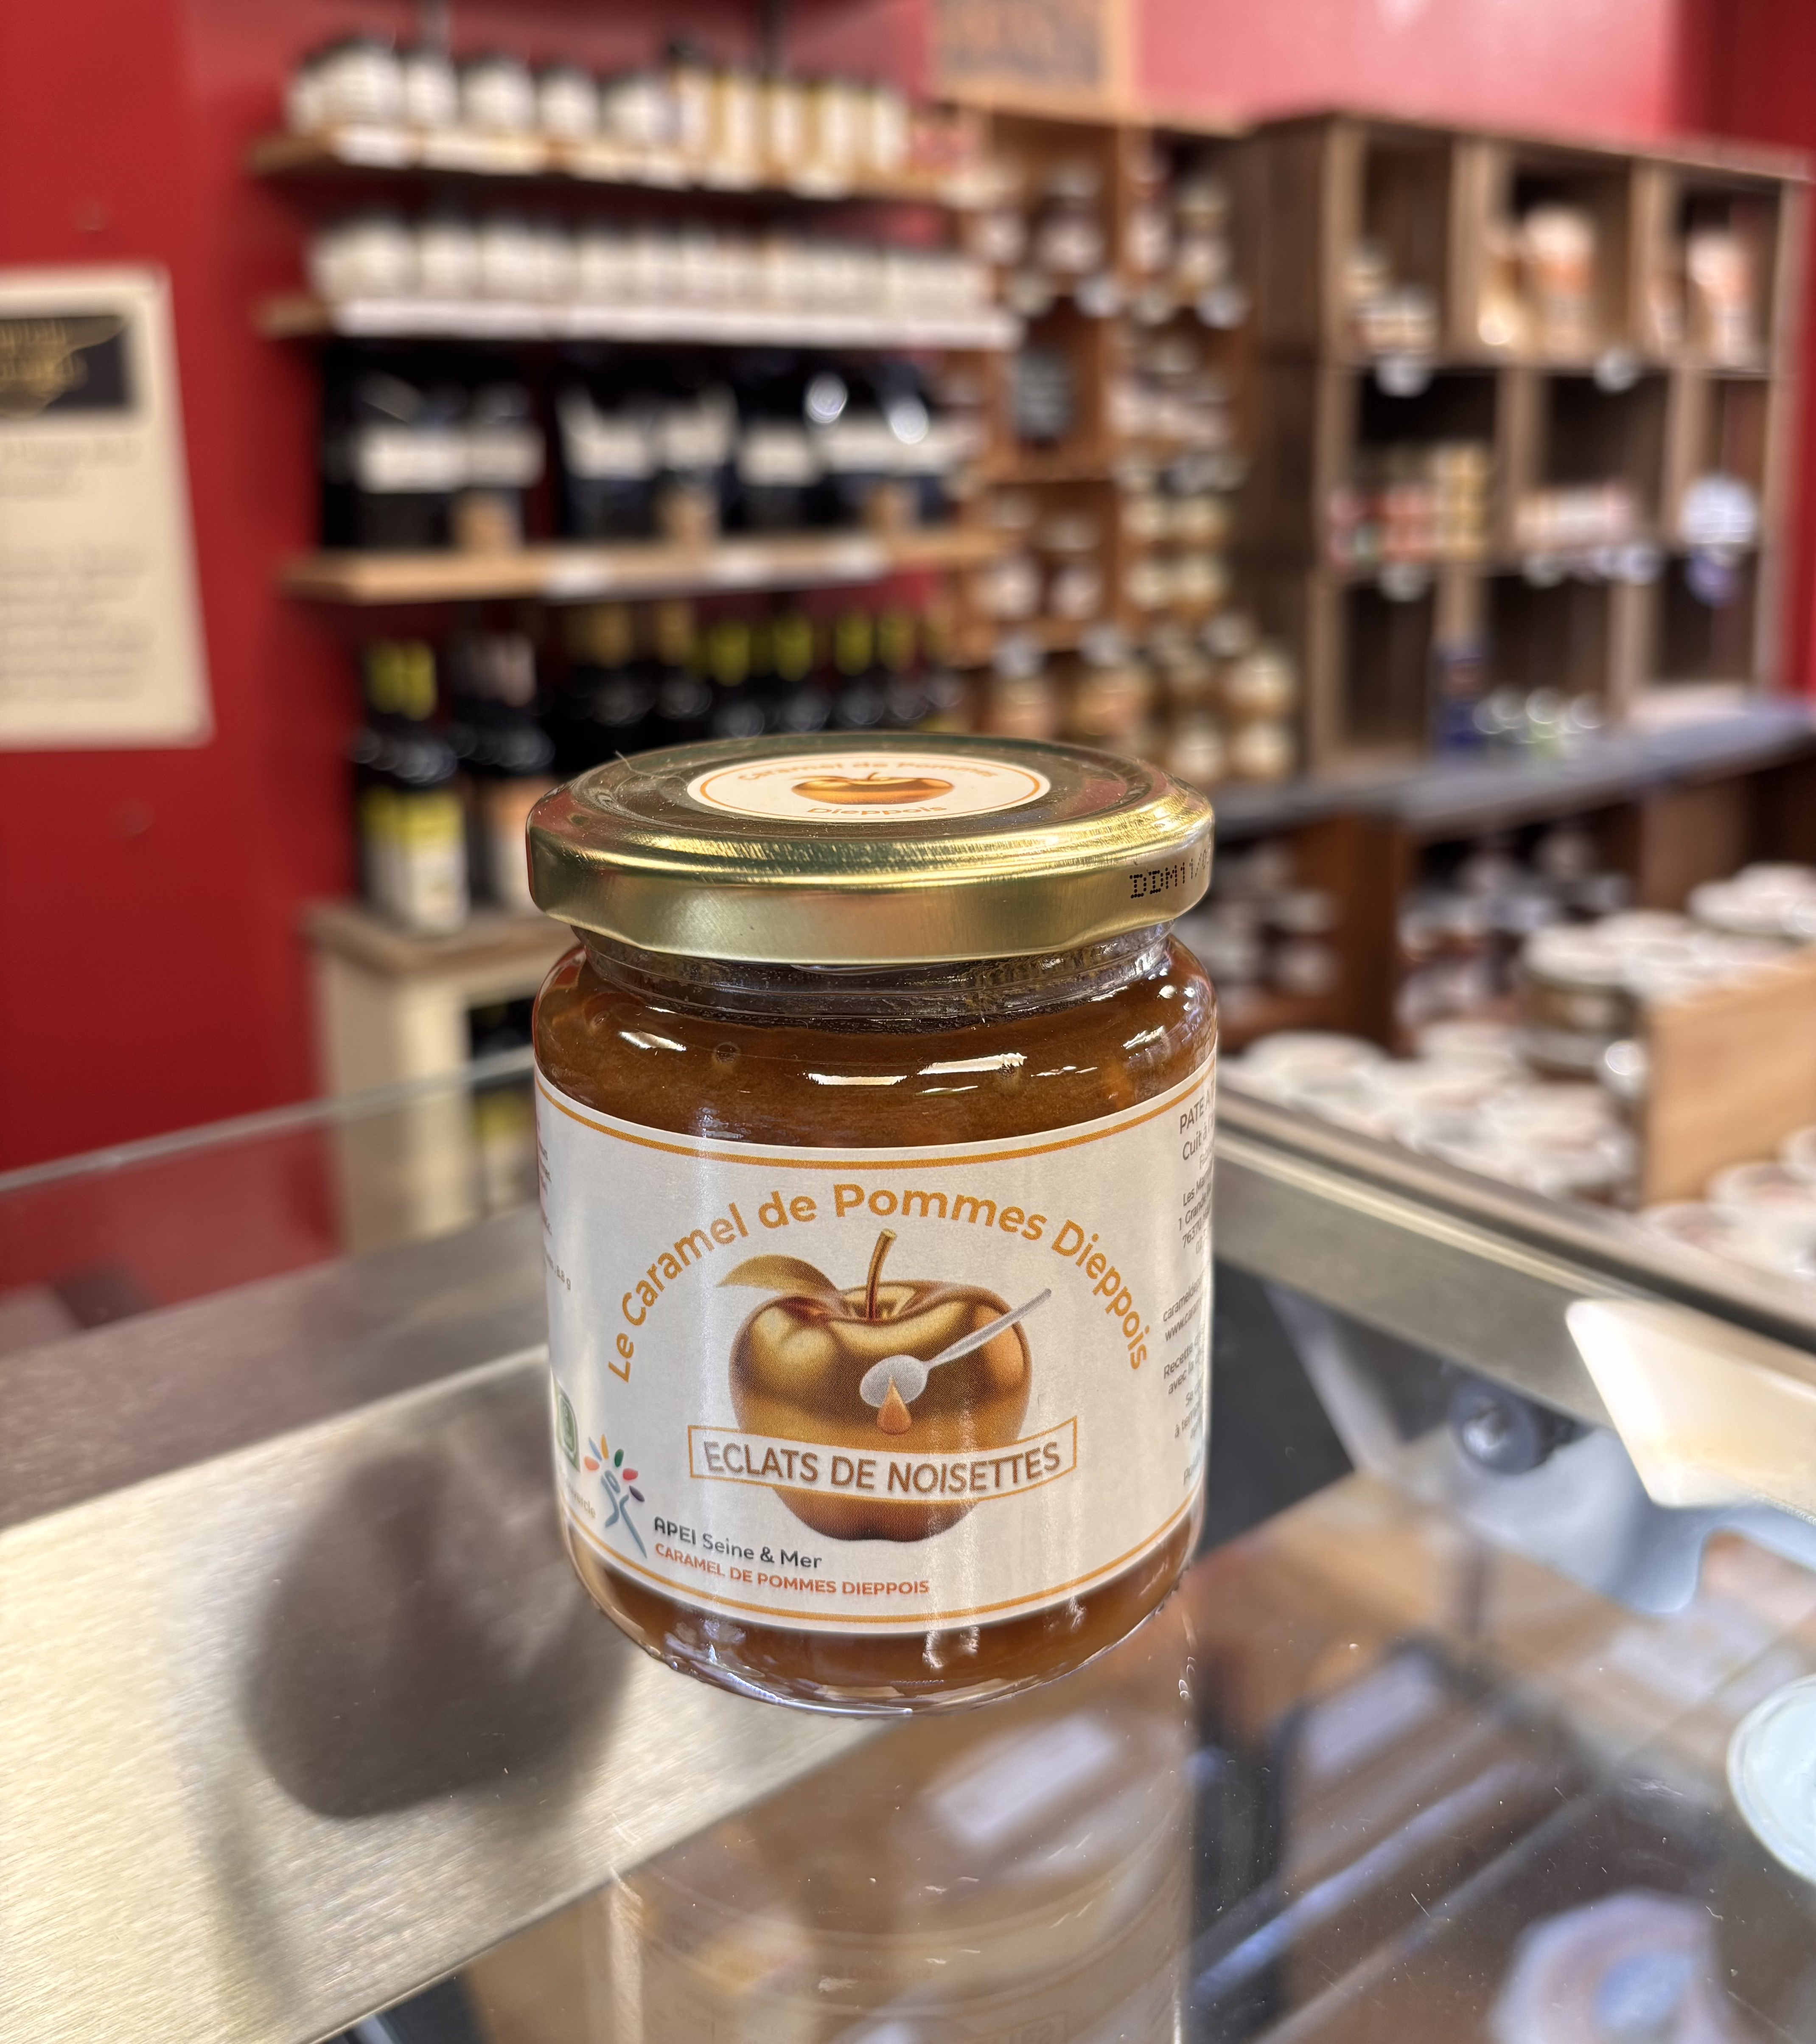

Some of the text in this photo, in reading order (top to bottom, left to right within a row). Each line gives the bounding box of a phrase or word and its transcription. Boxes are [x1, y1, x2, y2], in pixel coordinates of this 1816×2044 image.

[807, 807, 947, 815] Dieppois
[1180, 1096, 1204, 1134] PATE
[1183, 1130, 1202, 1161] Cuit
[1178, 1192, 1206, 1231] 1 Grande
[1183, 1188, 1195, 1207] Les
[608, 1183, 1149, 1383] Le Caramel de Pommes Dieppois
[1164, 1342, 1193, 1379] Recette
[1168, 1369, 1187, 1395] avec
[704, 1441, 1060, 1493] ECLATS DE NOISETTES
[654, 1516, 822, 1568] APEI Seine & Mer
[655, 1542, 930, 1595] CARAMEL DE POMMES DIEPPOIS
